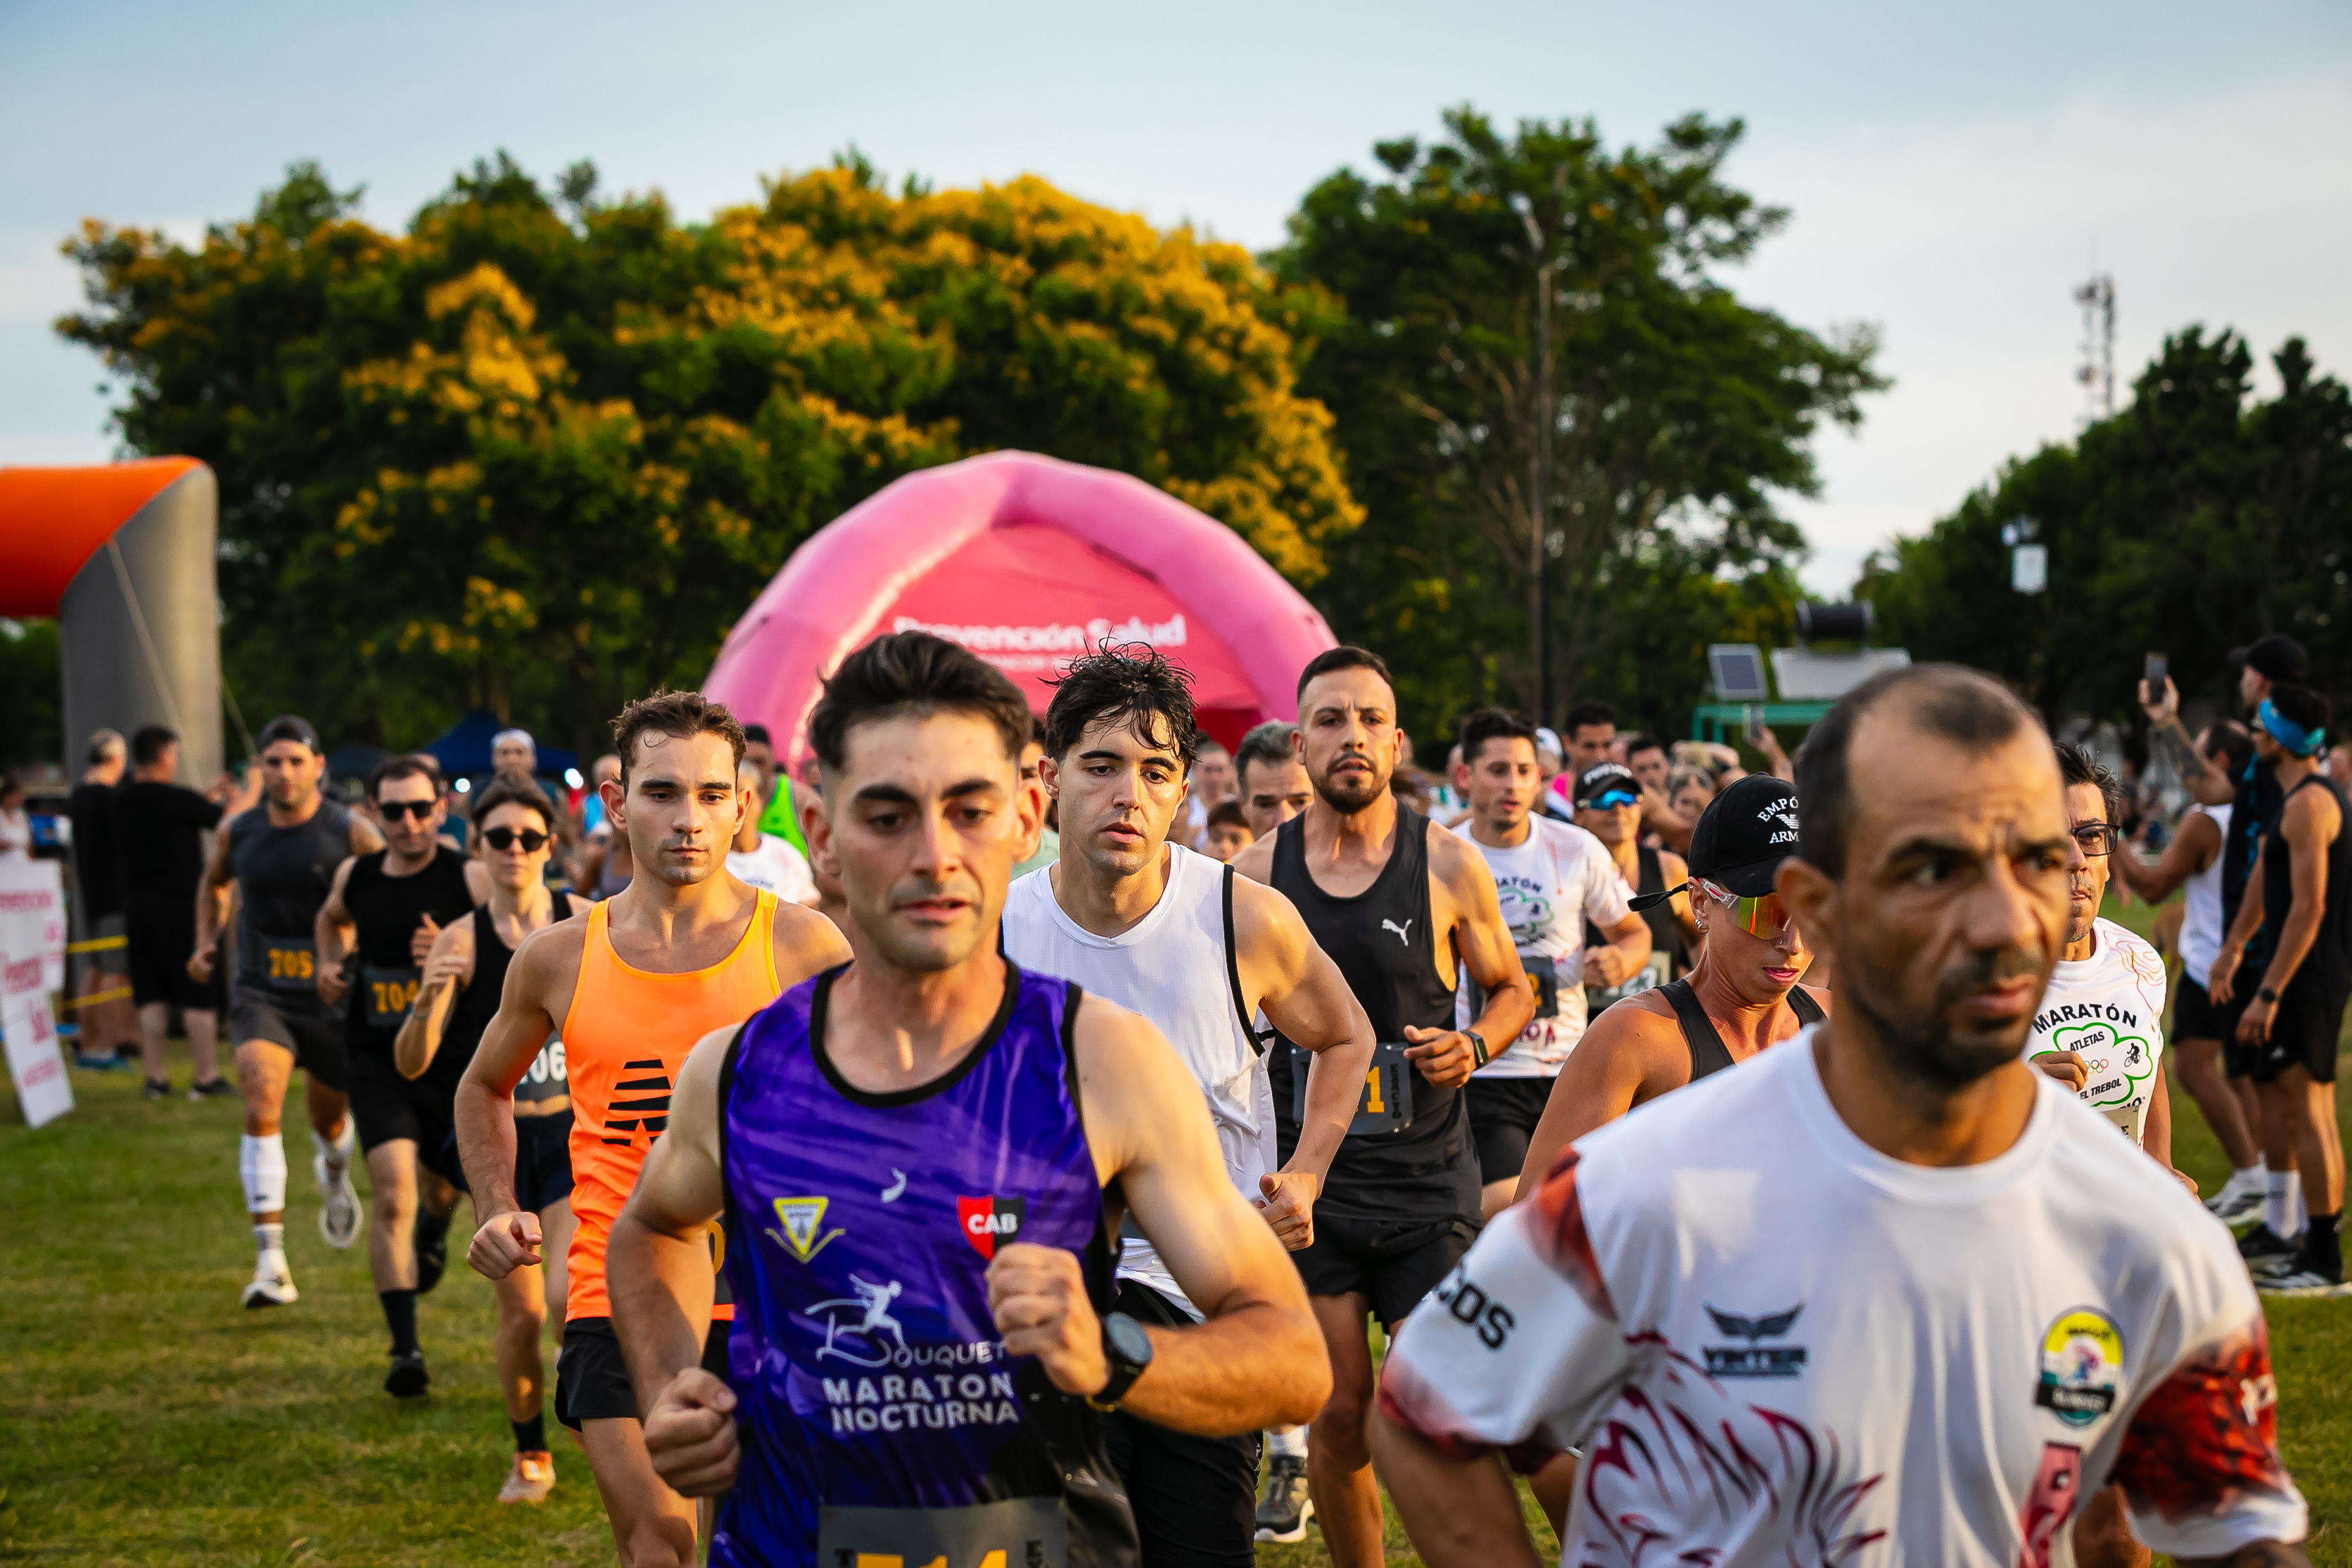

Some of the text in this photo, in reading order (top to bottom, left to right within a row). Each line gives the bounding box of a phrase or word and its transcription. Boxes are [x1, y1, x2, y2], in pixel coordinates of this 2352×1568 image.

[1769, 831, 1800, 843] ARM
[268, 949, 313, 979] 705
[2032, 1003, 2137, 1035] MARATÓN
[2070, 1031, 2105, 1052] ATLETAS
[520, 1041, 567, 1083] 06
[2080, 1078, 2122, 1099] EL TREBOL
[967, 1213, 1018, 1235] CAB
[822, 1372, 1015, 1405] MARATON
[831, 1401, 1019, 1433] NOCTURNA
